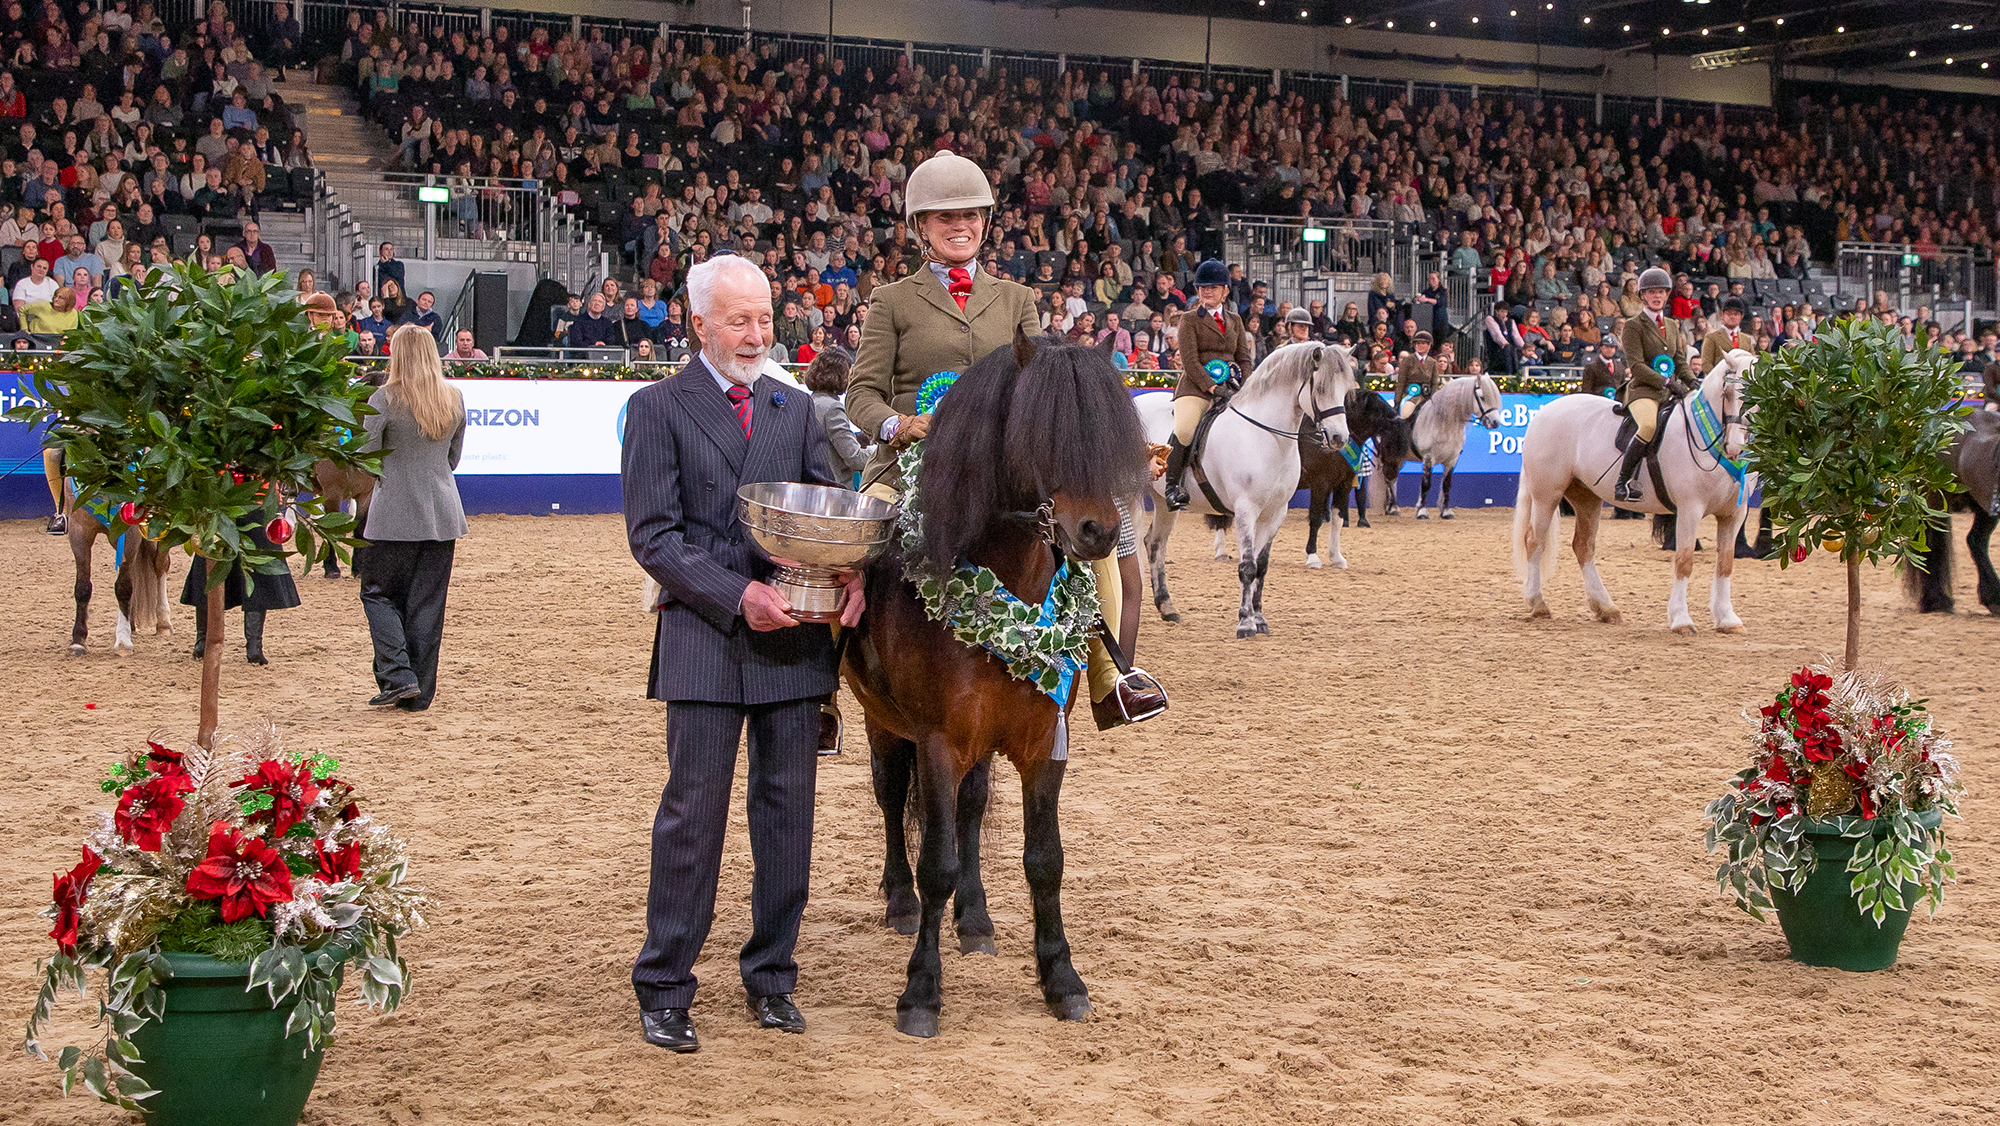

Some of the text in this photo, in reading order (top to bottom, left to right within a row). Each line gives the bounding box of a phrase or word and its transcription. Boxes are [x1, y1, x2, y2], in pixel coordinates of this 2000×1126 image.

[466, 408, 540, 427] RIZON
[461, 452, 509, 463] aste plastic
